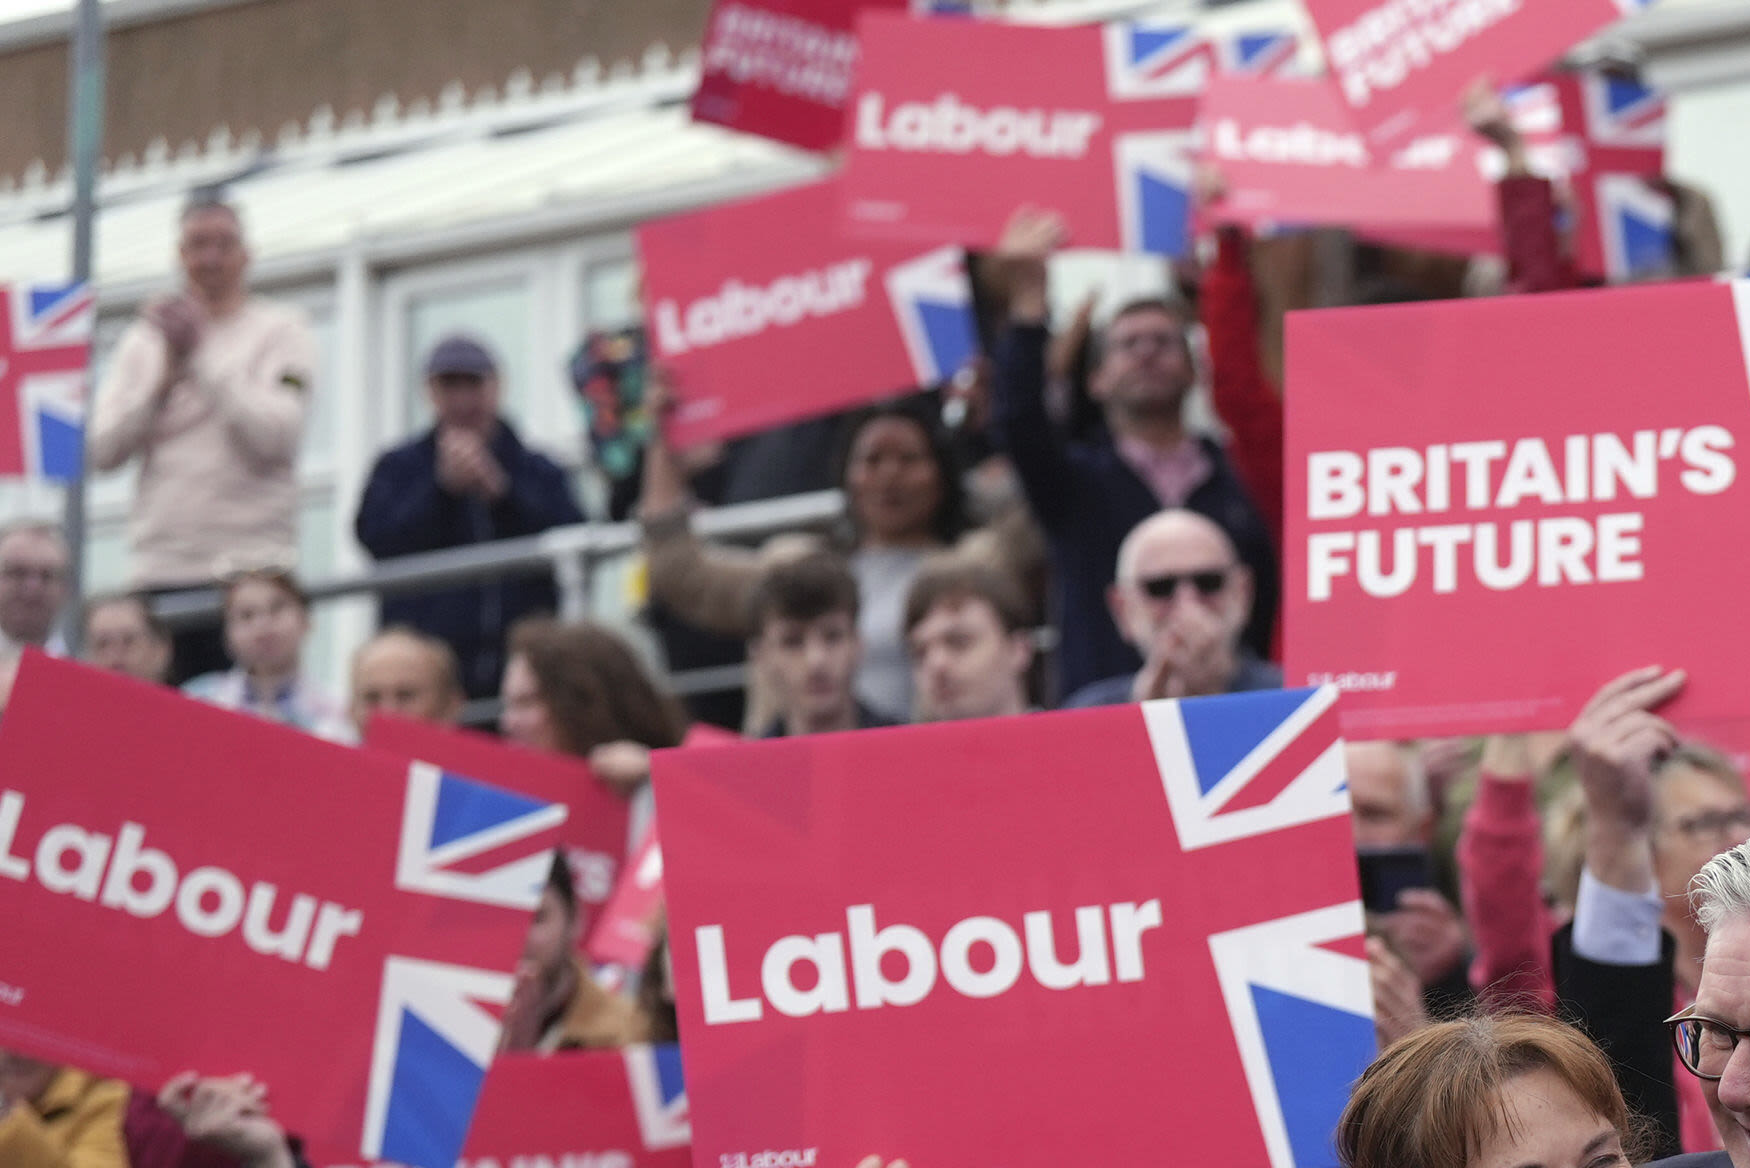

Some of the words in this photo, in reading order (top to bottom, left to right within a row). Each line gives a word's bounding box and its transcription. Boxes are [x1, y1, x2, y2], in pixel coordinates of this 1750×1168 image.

[857, 91, 1100, 158] Labour
[656, 256, 871, 355] Labour
[1308, 425, 1736, 519] BRITAIN'S
[1308, 512, 1643, 601] FUTURE
[0, 789, 363, 969] Labour
[695, 898, 1163, 1025] Labour
